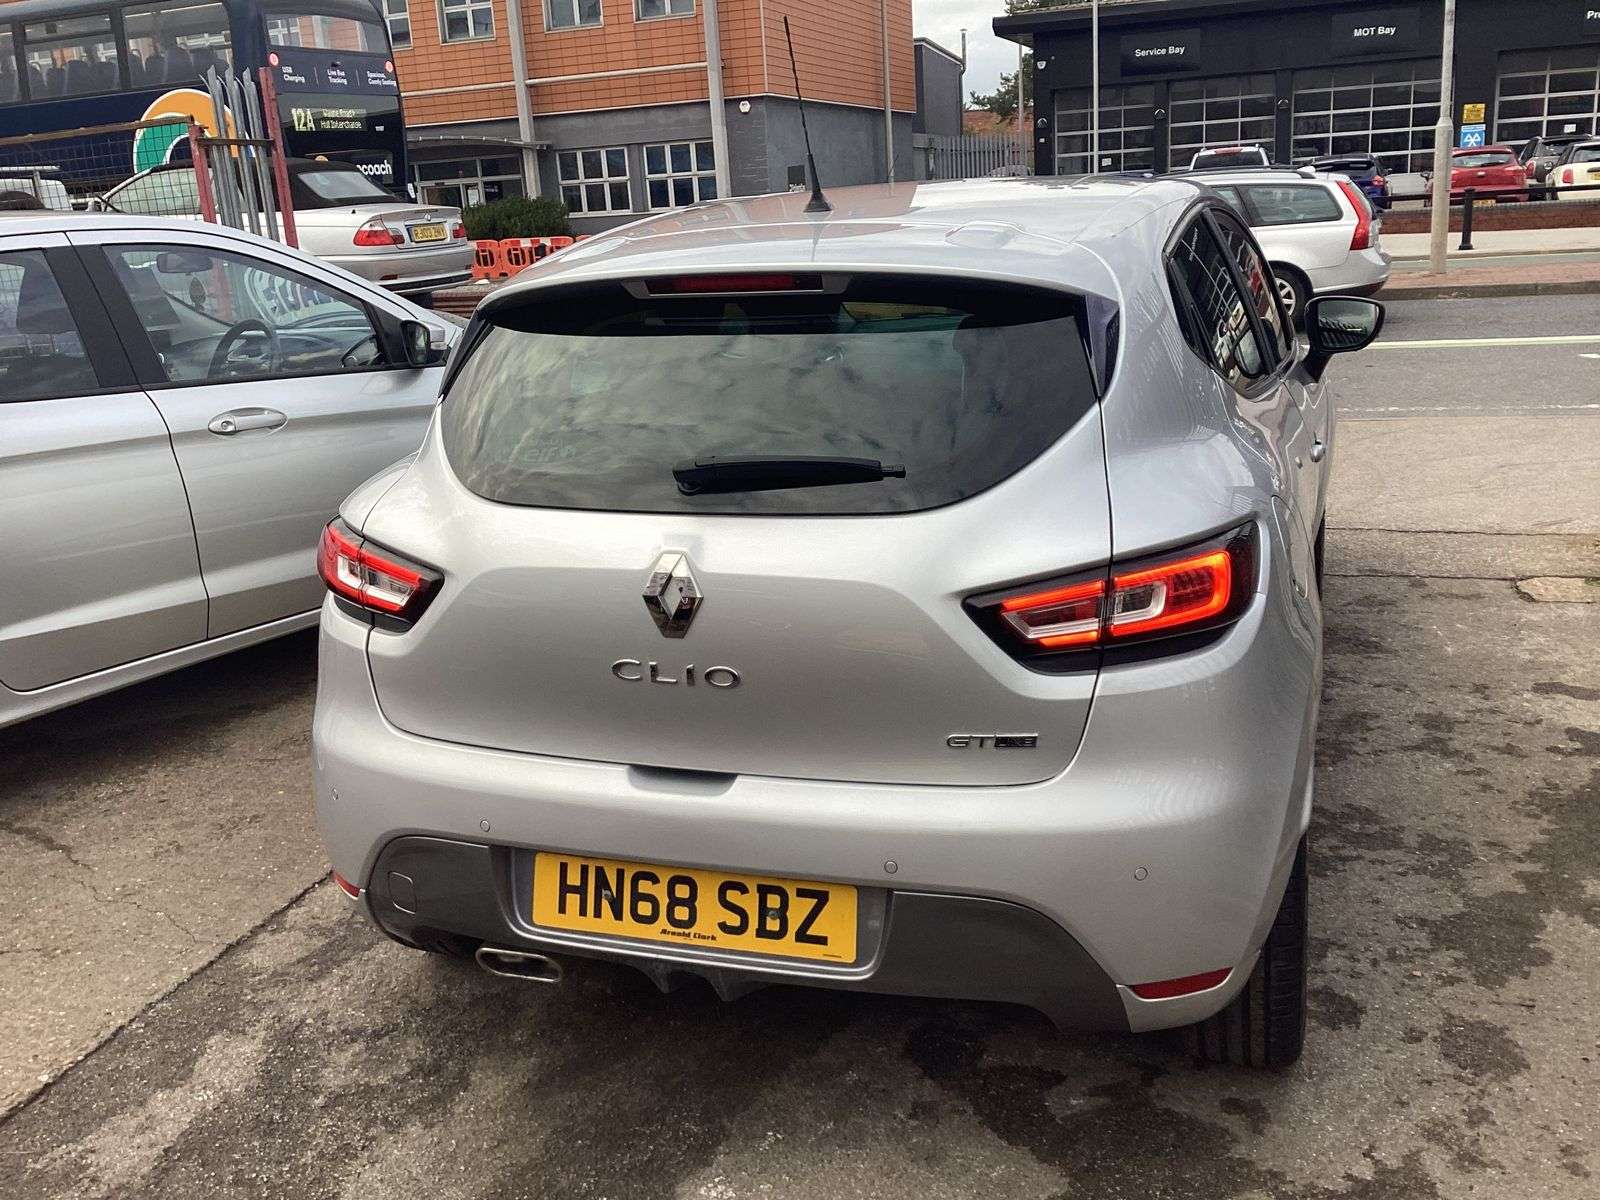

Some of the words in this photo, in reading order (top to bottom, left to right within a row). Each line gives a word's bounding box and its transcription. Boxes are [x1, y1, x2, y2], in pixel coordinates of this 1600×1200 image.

[1353, 27, 1376, 37] MOT
[1378, 26, 1396, 36] Bay
[1135, 48, 1167, 57] Service
[1168, 46, 1185, 55] Bay
[283, 74, 305, 83] Charging
[328, 76, 348, 85] Tracking
[291, 107, 316, 132] 12A
[612, 658, 741, 687] CLIO
[557, 861, 699, 930] HN68
[717, 880, 831, 946] SBZ
[660, 928, 691, 938] Arnold
[693, 932, 717, 941] Clark
